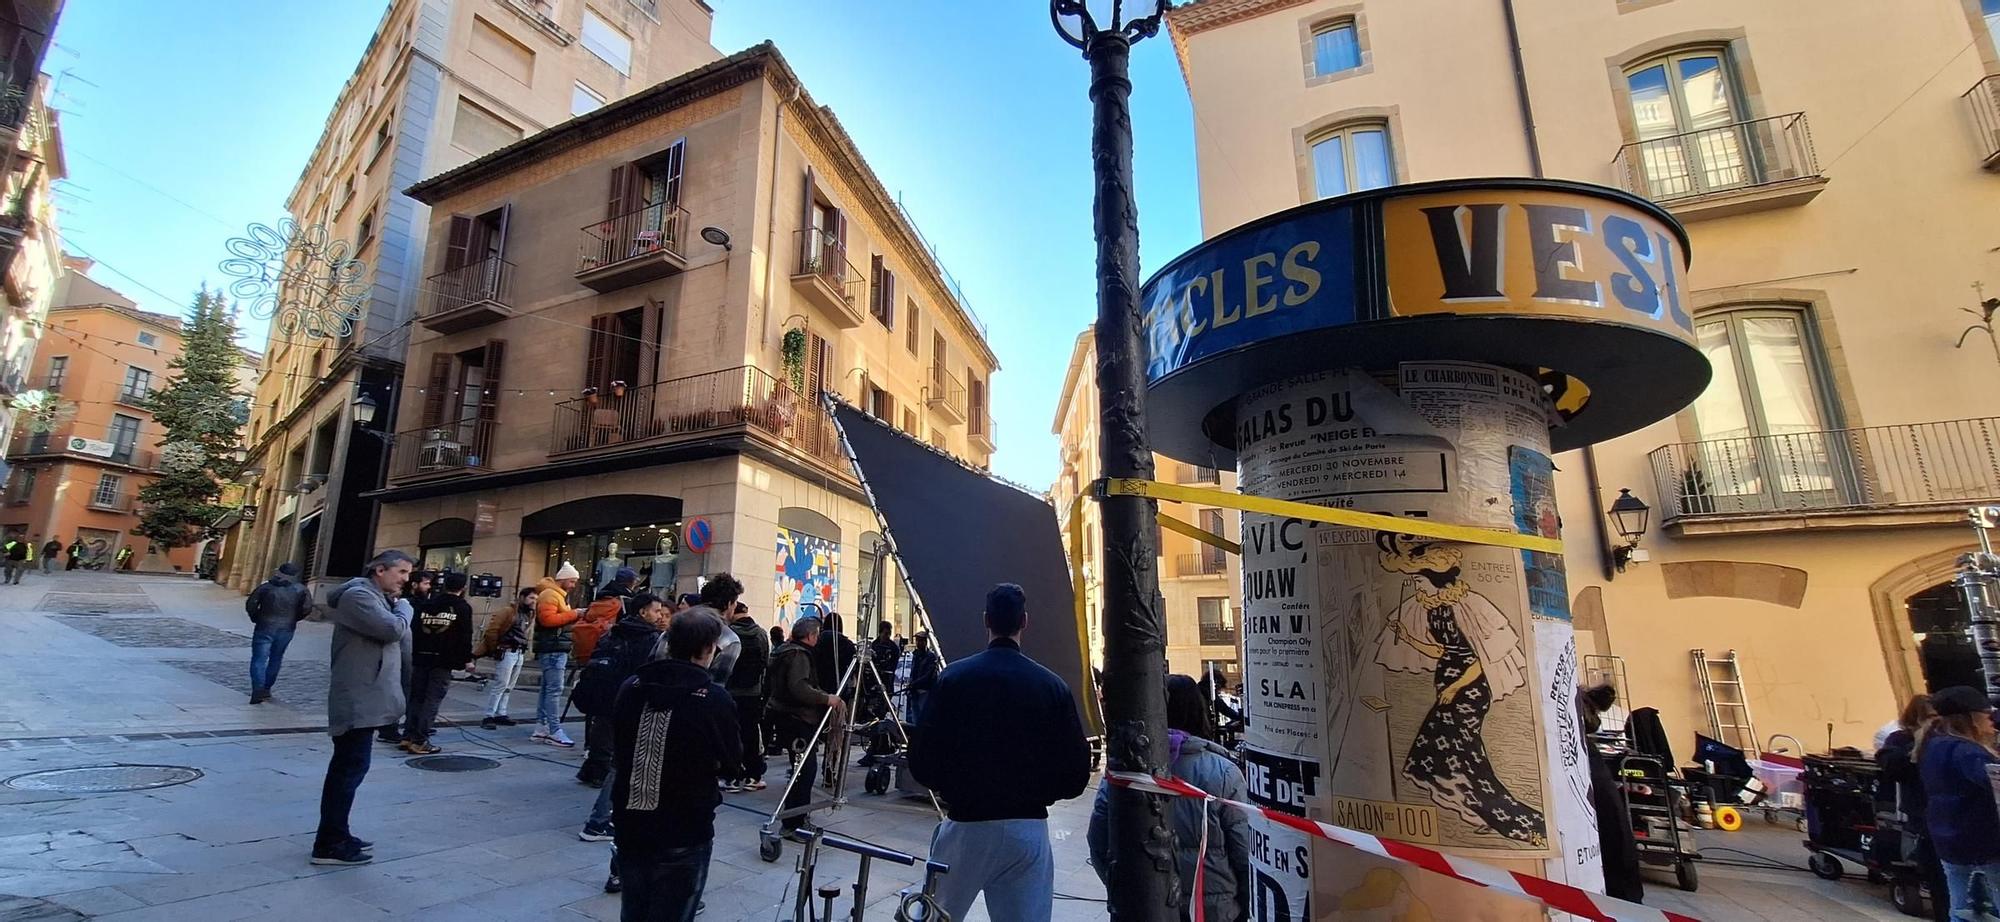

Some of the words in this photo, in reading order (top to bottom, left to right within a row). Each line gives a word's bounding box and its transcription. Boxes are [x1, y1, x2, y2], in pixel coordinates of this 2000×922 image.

[1405, 370, 1418, 383] LE
[1424, 369, 1495, 387] CHARBONNIER
[1237, 403, 1293, 453] GALAS
[1306, 391, 1354, 427] DU
[1279, 440, 1306, 451] Revue
[1303, 449, 1326, 458] Comité
[1327, 461, 1338, 471] 30
[1343, 456, 1404, 468] NOVEMBRE
[1277, 477, 1320, 489] VENDREDI
[1323, 474, 1329, 482] 9
[1333, 470, 1387, 481] MERCREDI
[1394, 469, 1406, 478] 14
[1471, 559, 1512, 573] ENTRÉE
[1477, 573, 1491, 583] 50
[1248, 615, 1280, 634] JEAN
[1290, 615, 1311, 634] V
[1550, 653, 1566, 702] RECTOR
[1276, 778, 1306, 808] DE
[1337, 800, 1384, 832] SALON
[1397, 807, 1432, 838] 100
[1274, 848, 1289, 873] EN
[1295, 846, 1309, 879] S
